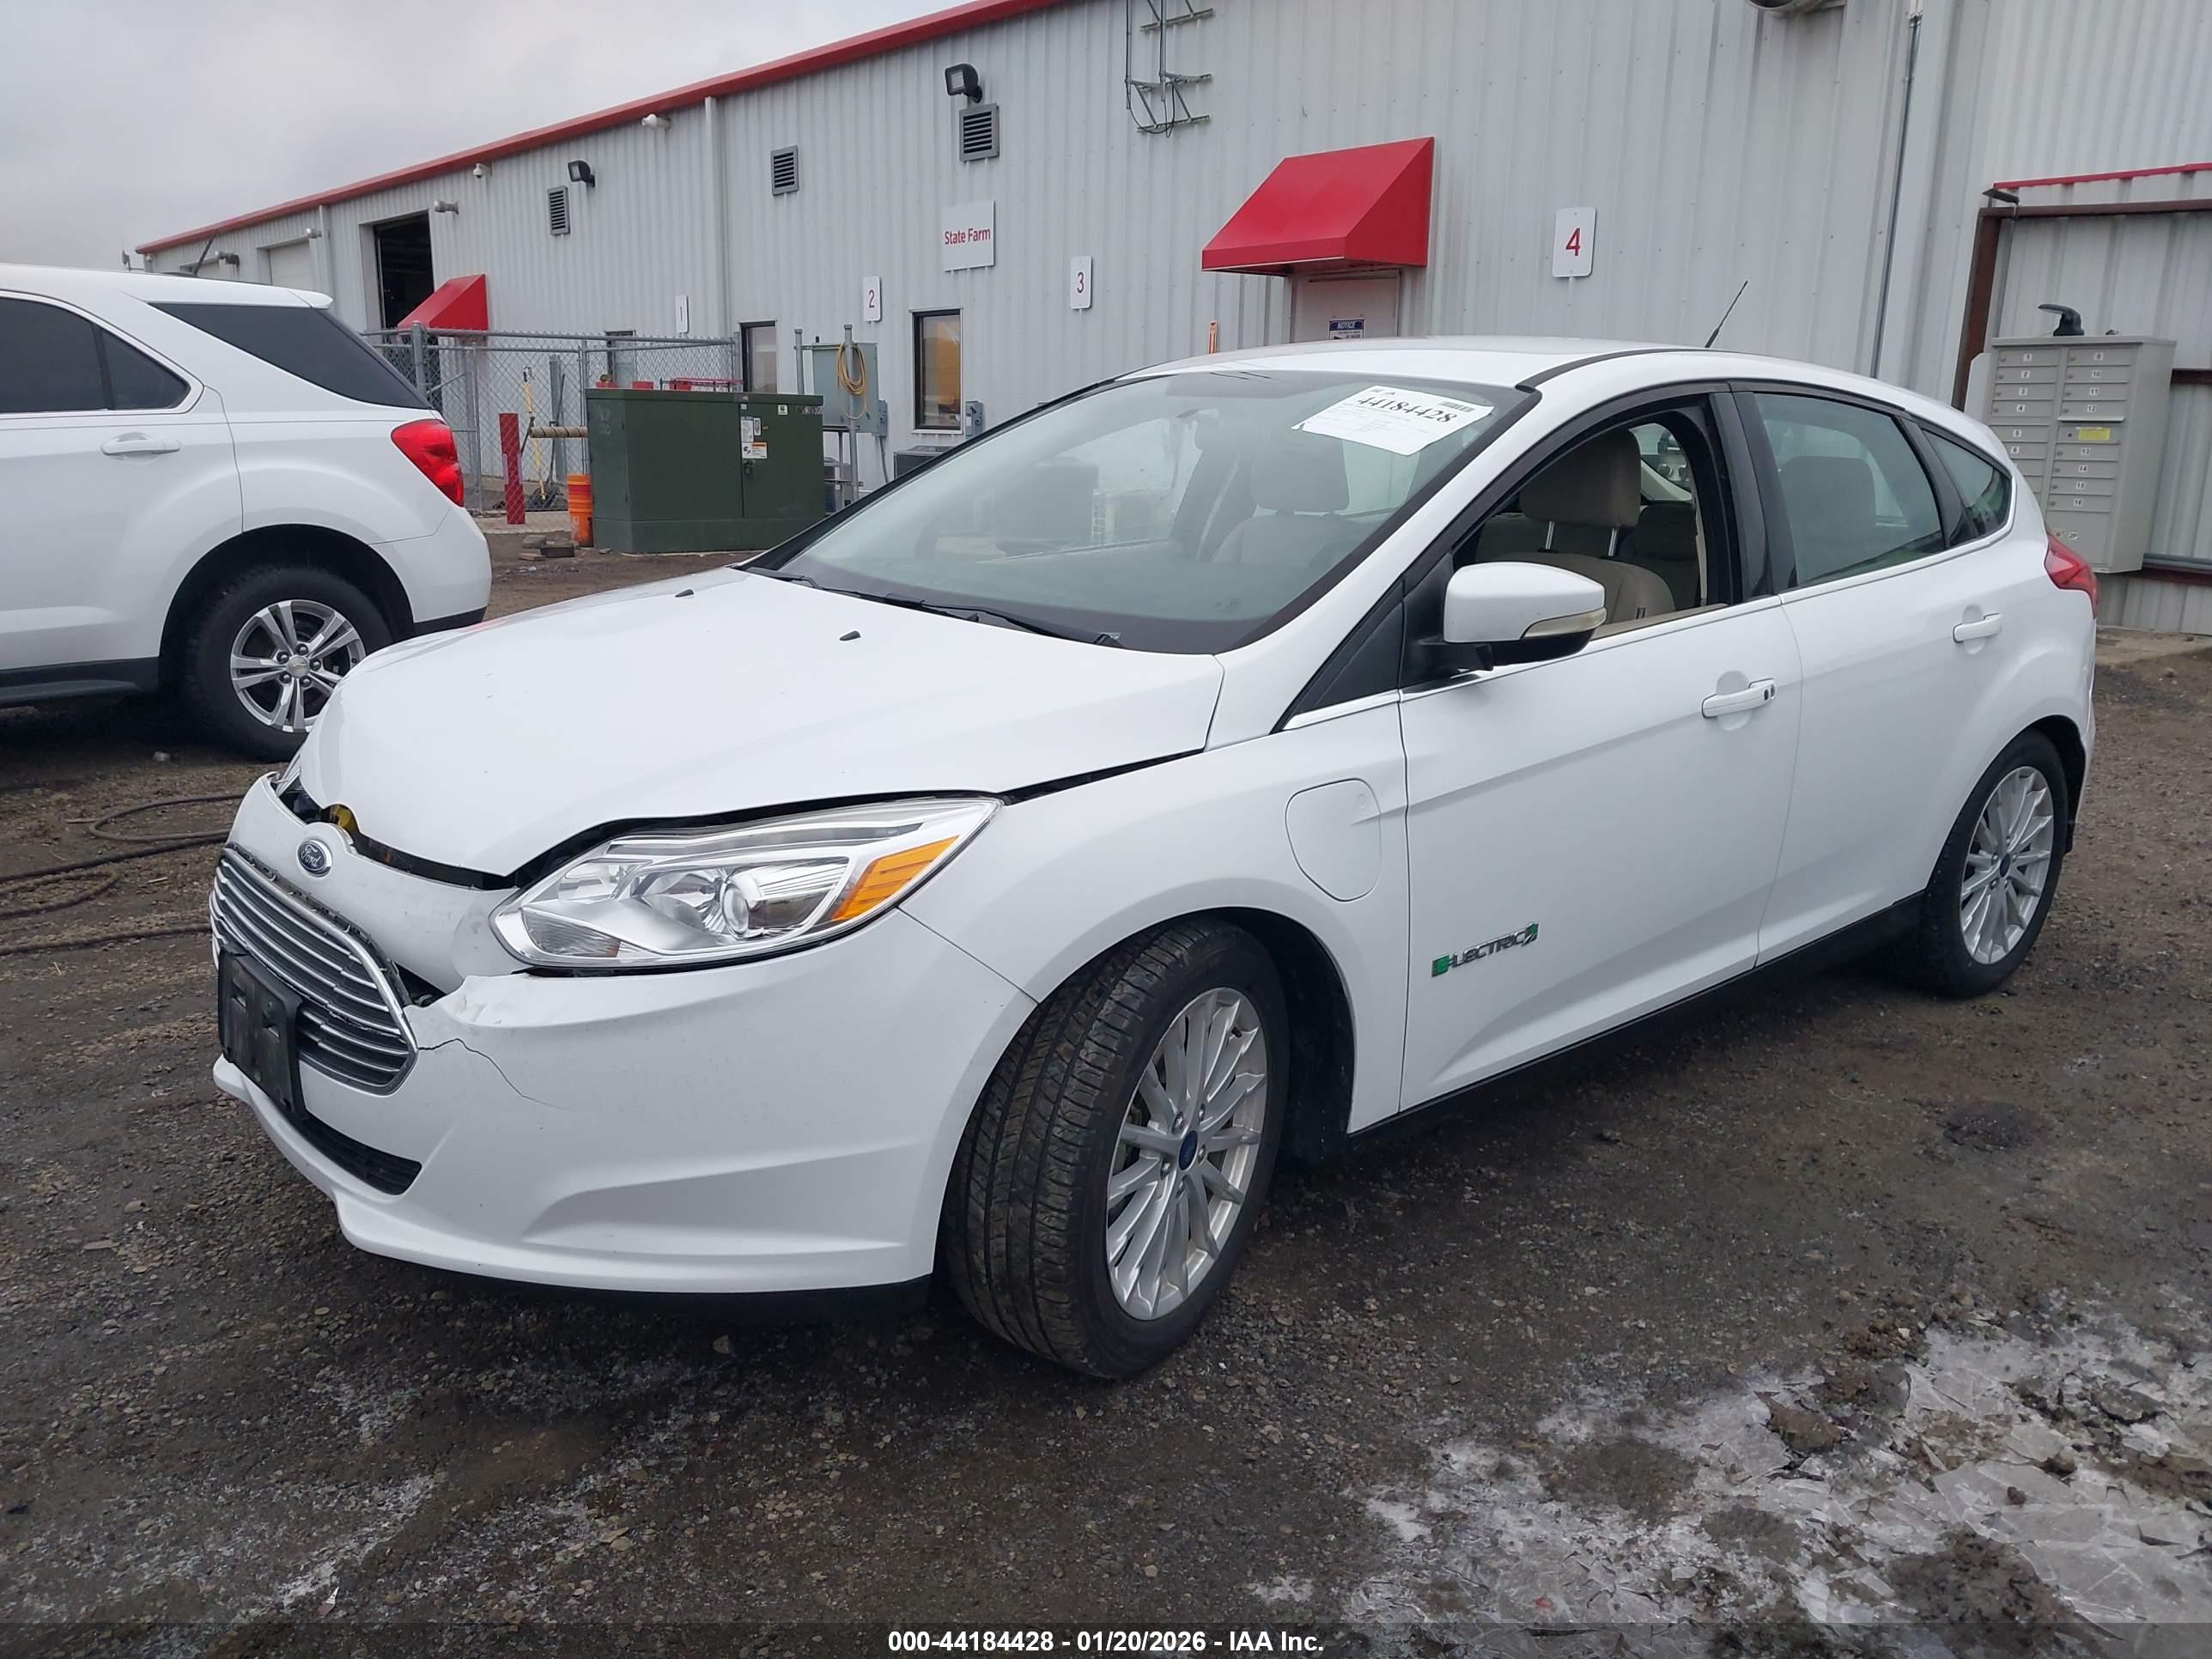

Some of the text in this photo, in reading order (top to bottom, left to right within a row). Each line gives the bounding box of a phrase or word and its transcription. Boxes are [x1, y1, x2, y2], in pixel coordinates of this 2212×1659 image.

[944, 228, 991, 245] State Farm
[1565, 227, 1581, 257] 4
[1077, 271, 1085, 294] 3
[868, 289, 875, 309] 2
[1337, 321, 1356, 330] NOTICE
[1358, 396, 1458, 423] 44184428
[301, 844, 322, 868] Ford
